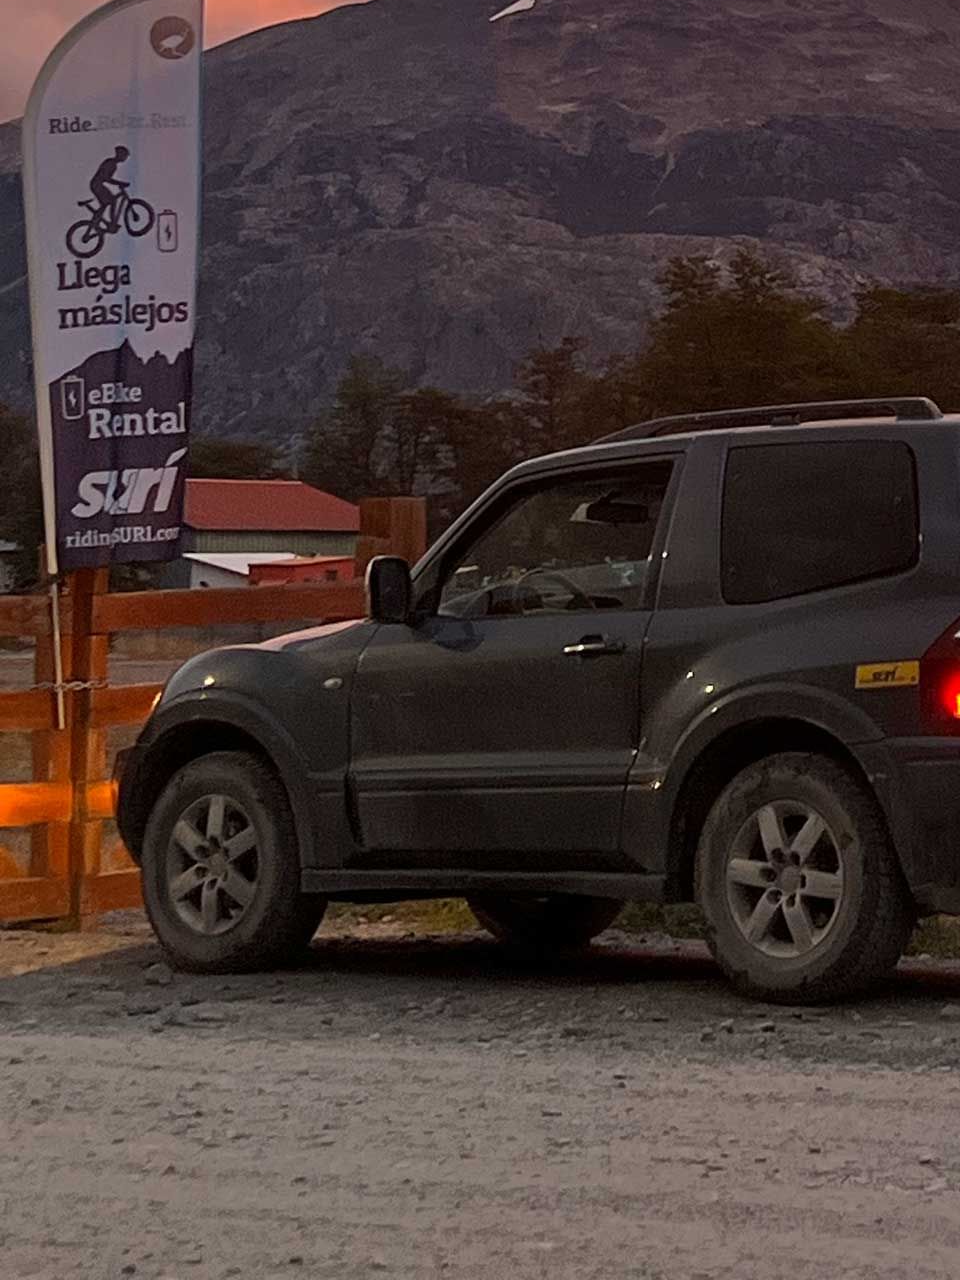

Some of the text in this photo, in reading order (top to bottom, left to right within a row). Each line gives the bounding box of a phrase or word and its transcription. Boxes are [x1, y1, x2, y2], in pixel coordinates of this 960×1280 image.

[56, 260, 131, 294] Llega
[88, 382, 142, 405] eBke
[88, 401, 186, 439] Rental
